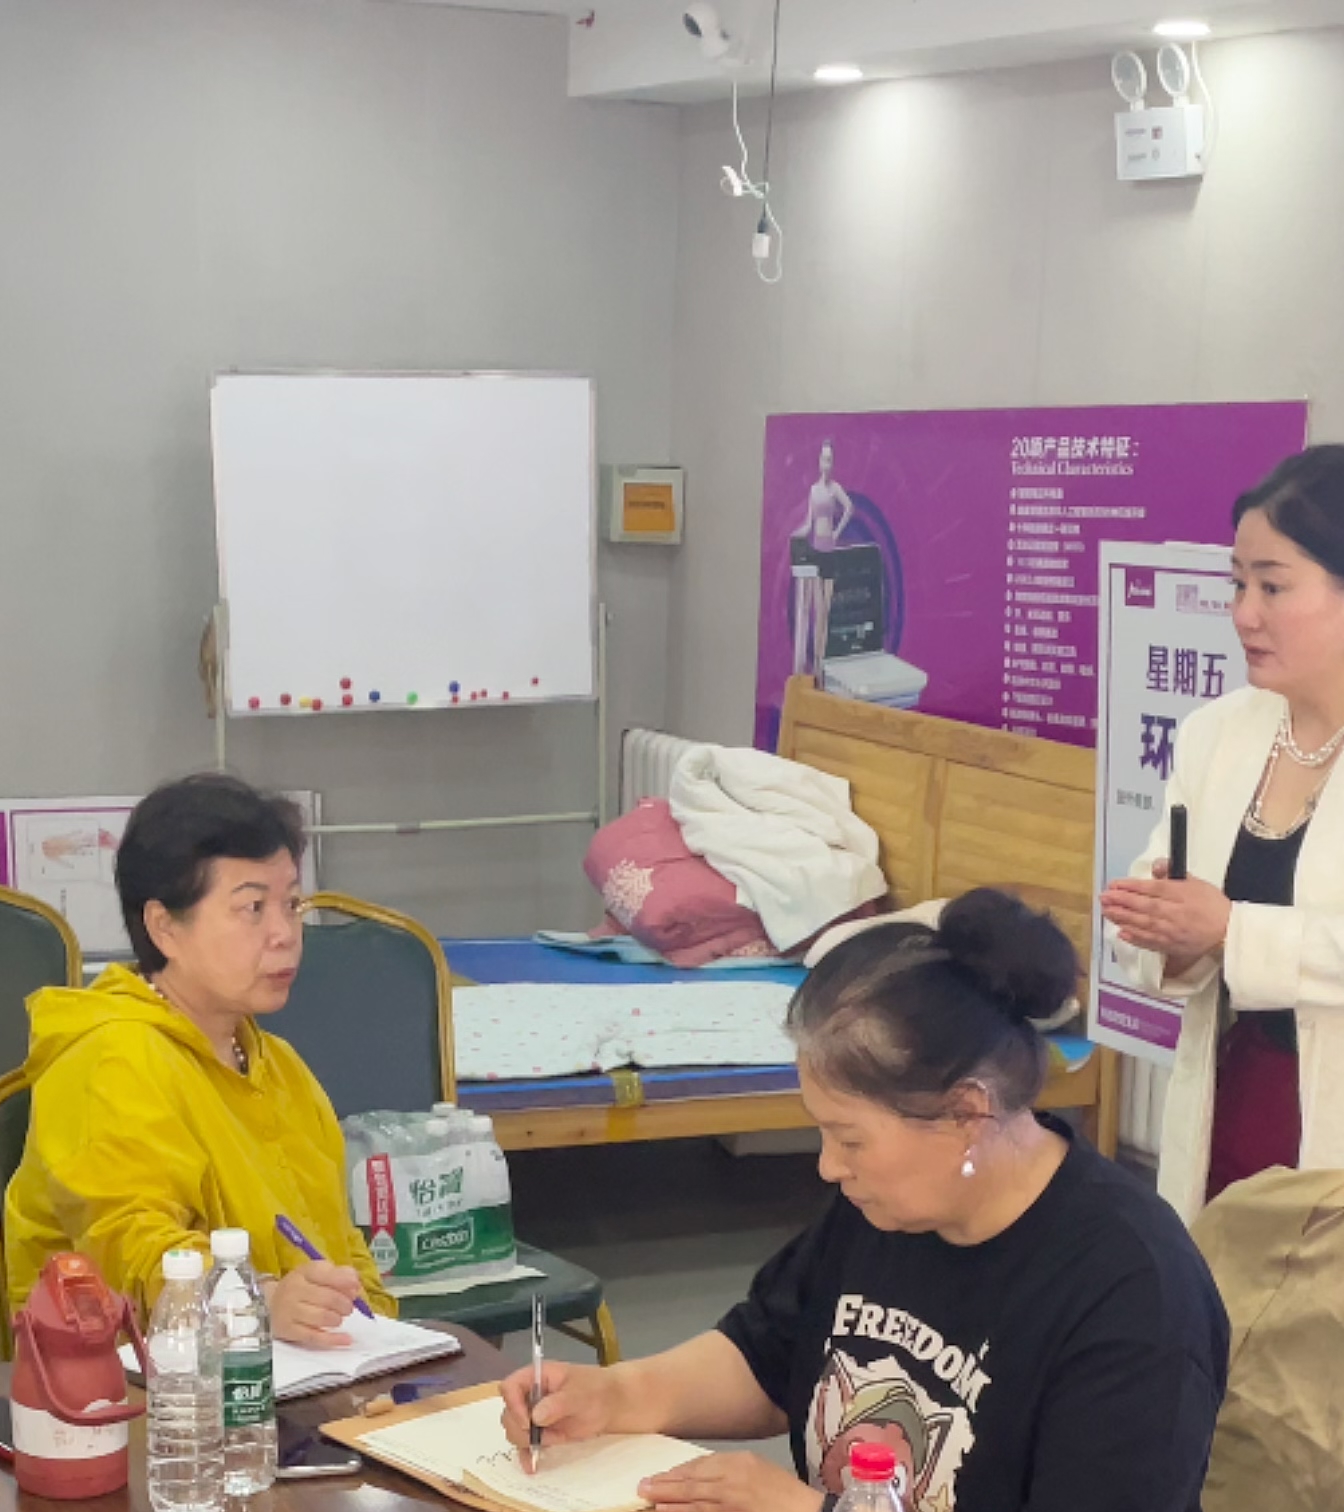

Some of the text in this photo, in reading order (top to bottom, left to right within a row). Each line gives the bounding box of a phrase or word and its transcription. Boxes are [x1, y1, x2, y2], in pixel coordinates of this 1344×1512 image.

[1146, 644, 1227, 698] 星期五
[832, 1293, 993, 1414] FREEDOM
